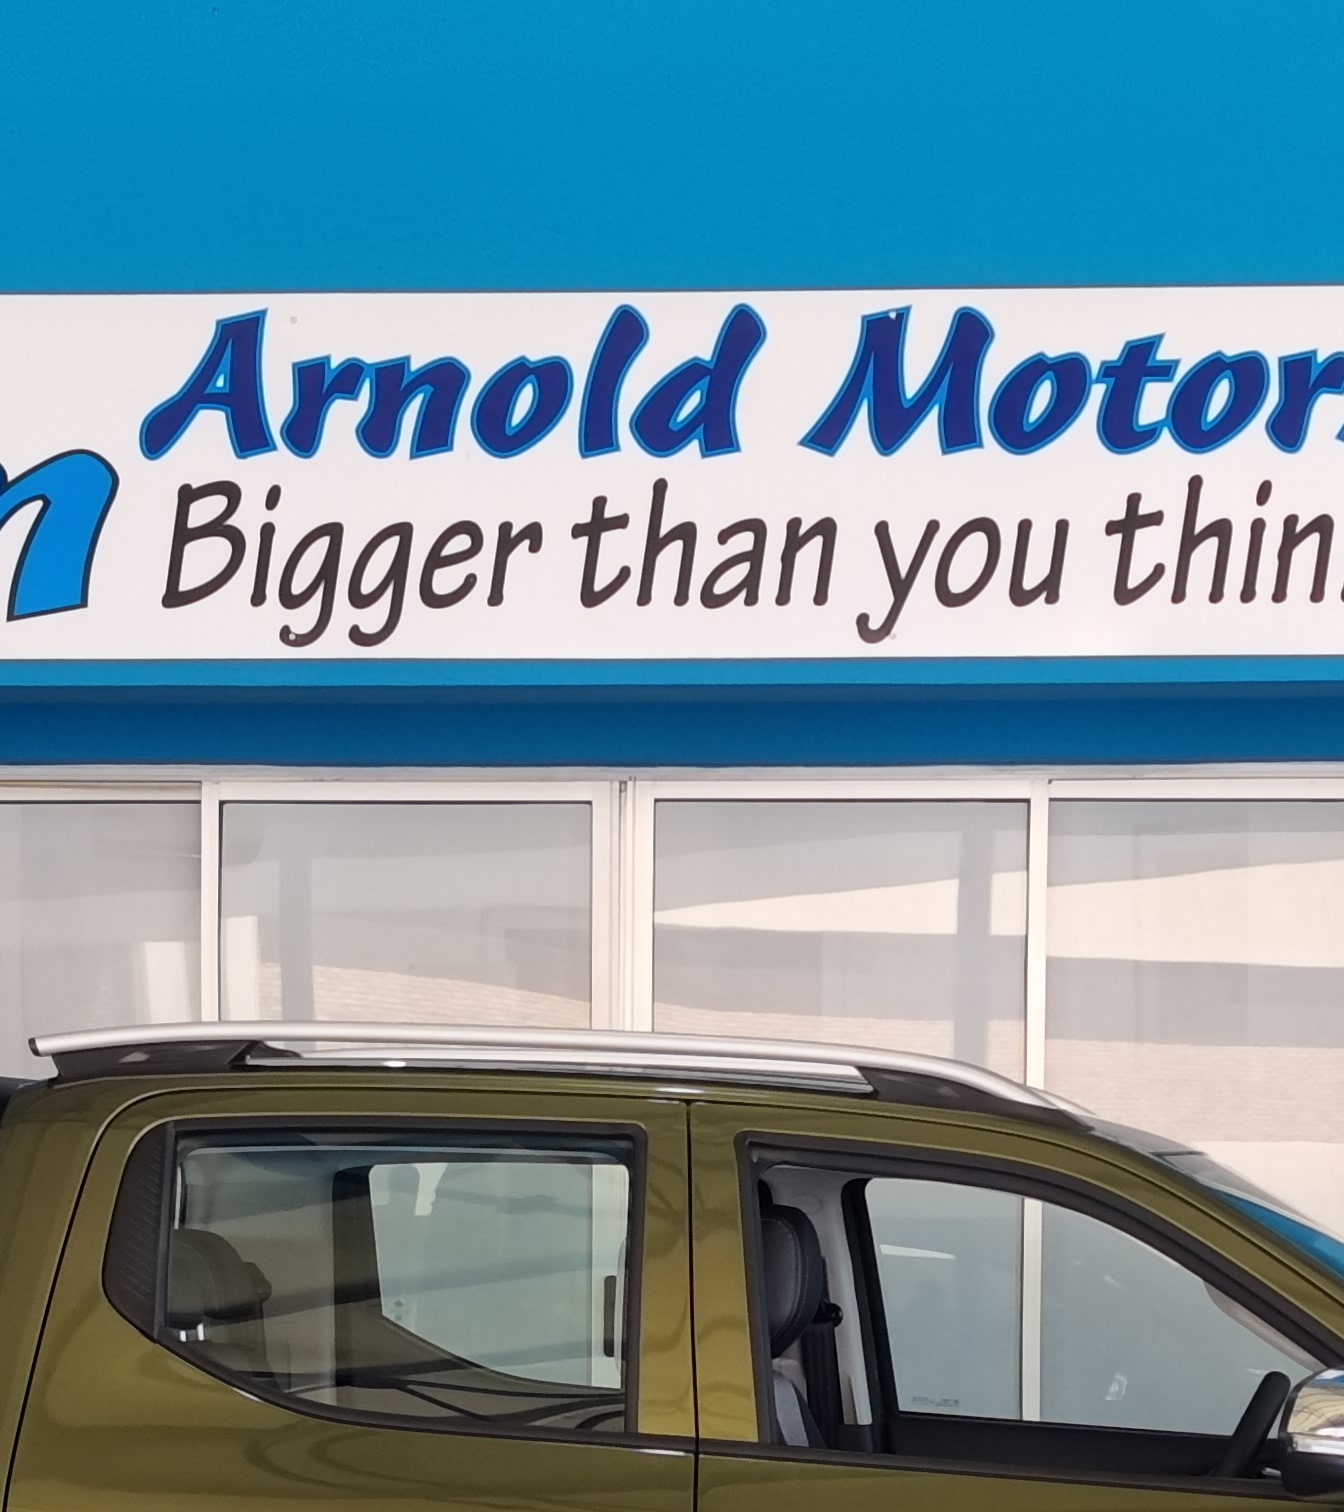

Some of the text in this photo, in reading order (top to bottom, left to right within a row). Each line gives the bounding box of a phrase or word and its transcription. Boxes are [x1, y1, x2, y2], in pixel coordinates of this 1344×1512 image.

[139, 303, 767, 461] Arnold
[161, 478, 543, 647] Bigger
[571, 478, 838, 610] than
[855, 516, 1069, 644] you
